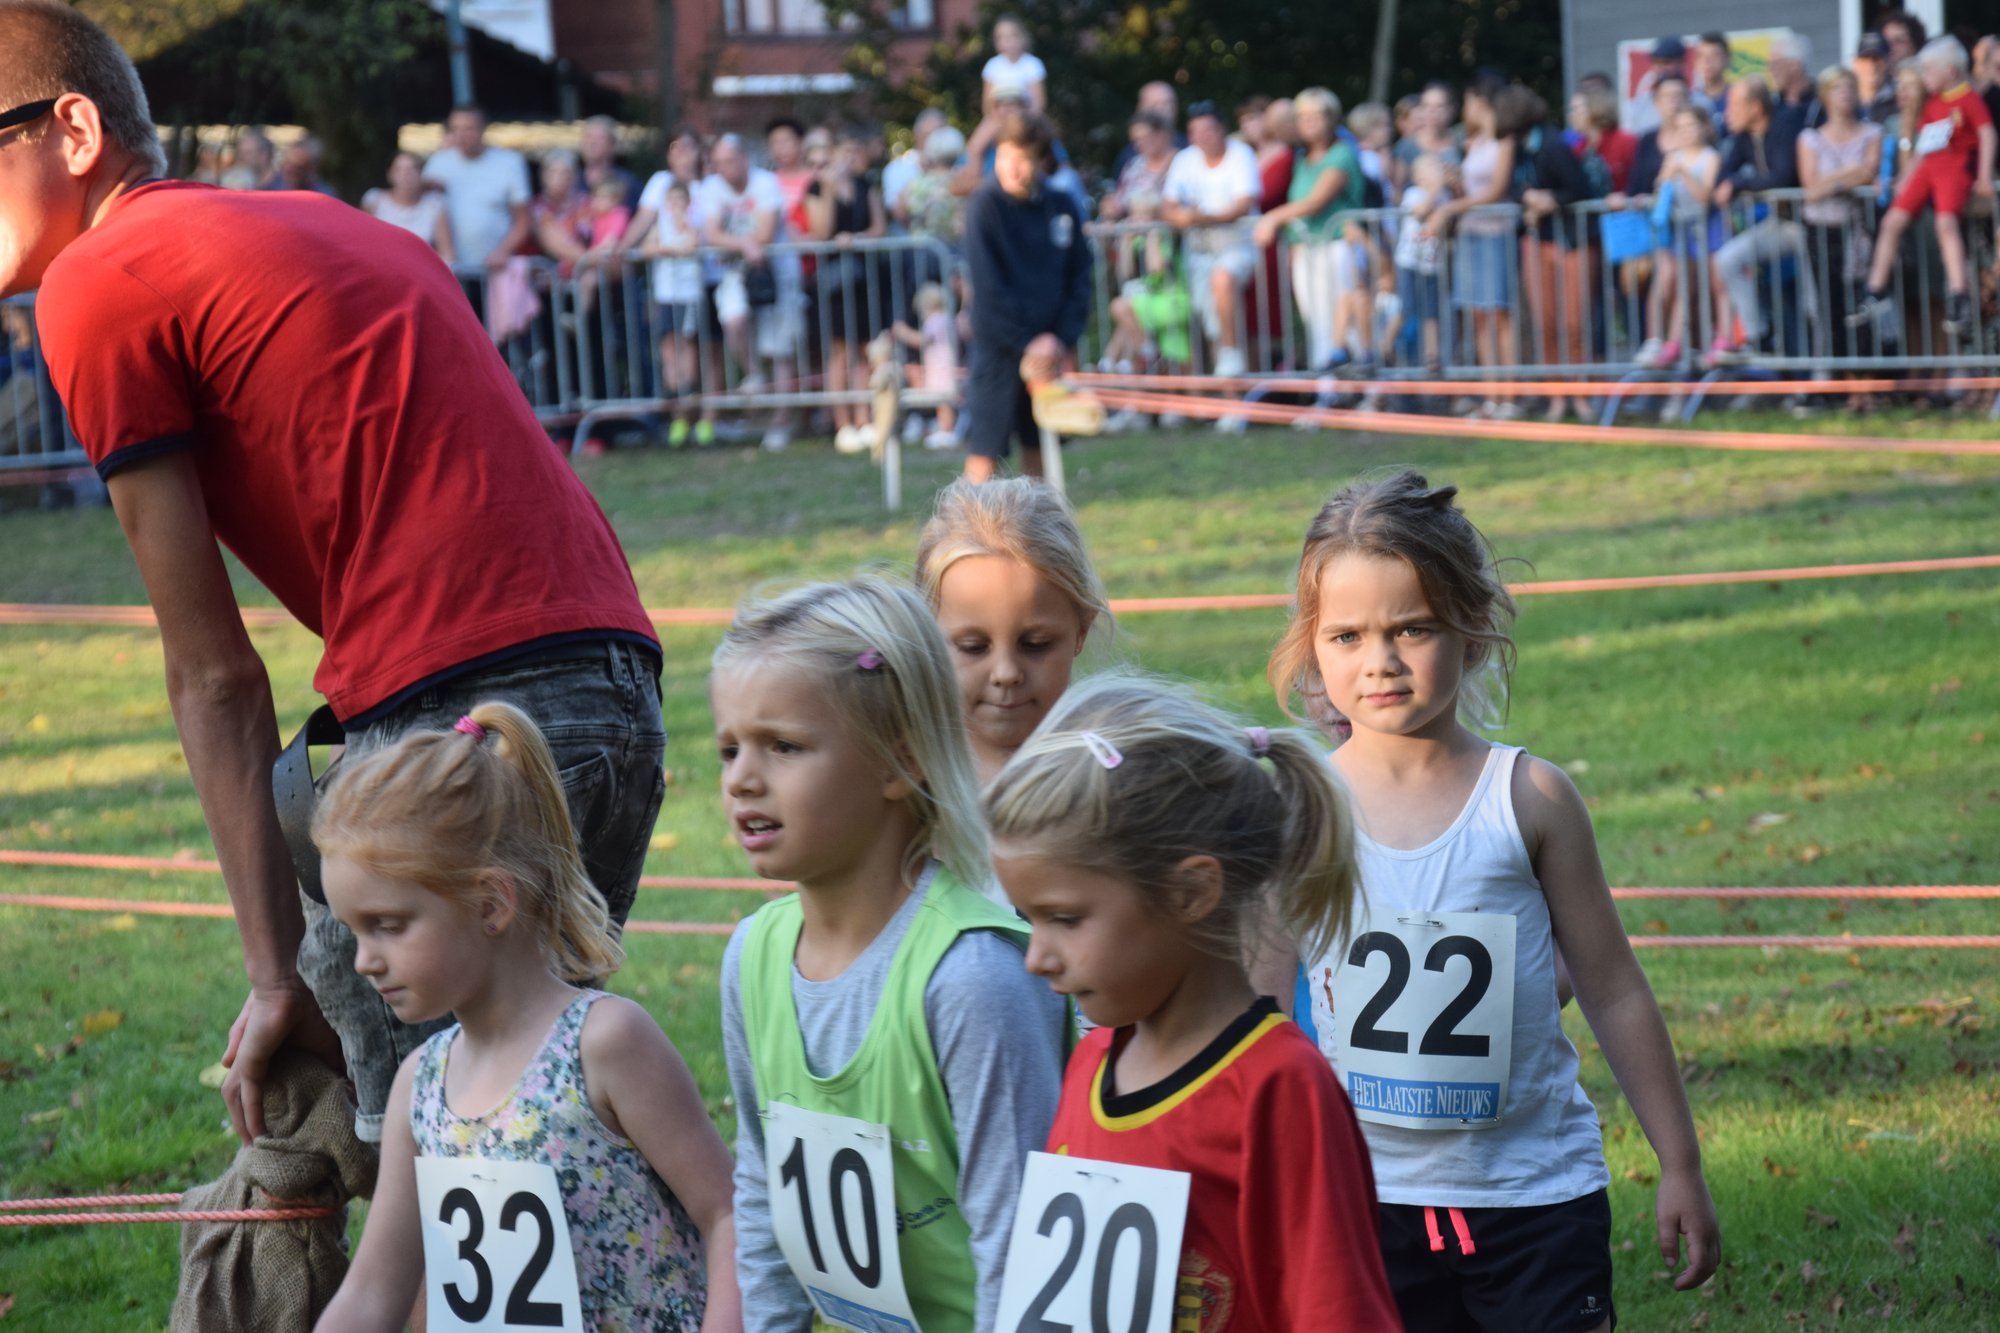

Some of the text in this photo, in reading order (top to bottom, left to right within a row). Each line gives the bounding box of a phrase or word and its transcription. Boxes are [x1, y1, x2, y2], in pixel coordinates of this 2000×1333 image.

[1347, 931, 1493, 1058] 22
[439, 1187, 563, 1326] 32
[780, 1136, 881, 1289] 10
[1014, 1191, 1158, 1333] 20
